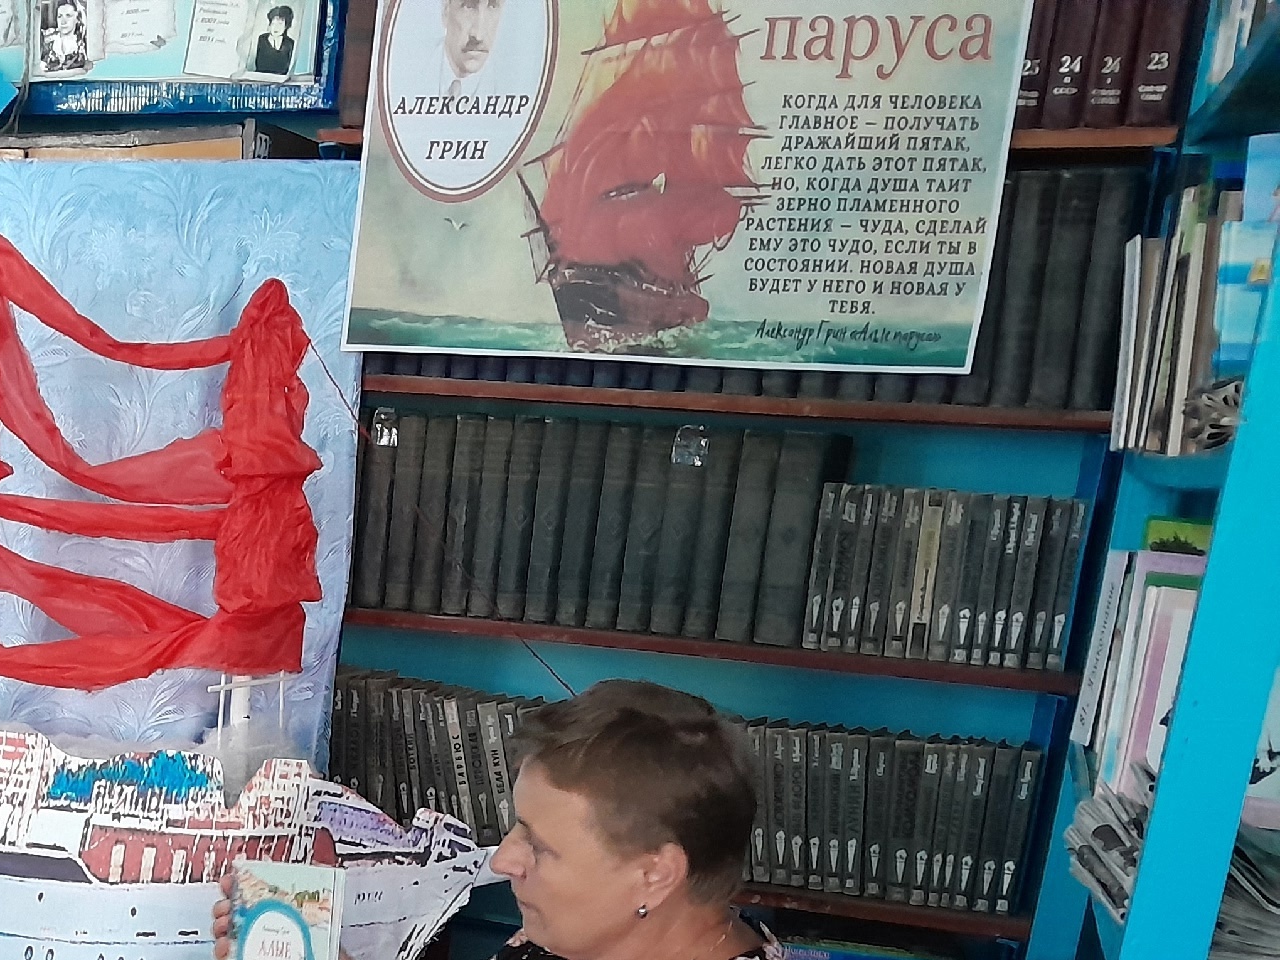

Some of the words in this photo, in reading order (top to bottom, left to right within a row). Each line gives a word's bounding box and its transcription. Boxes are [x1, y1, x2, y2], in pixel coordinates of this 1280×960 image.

[759, 14, 992, 80] паруса
[1021, 59, 1041, 76] 25
[1058, 55, 1083, 74] 24
[1101, 55, 1121, 74] 24
[1146, 52, 1169, 71] 23
[393, 95, 530, 118] АЛЕКСАНДР
[781, 94, 839, 112] КОГДА
[843, 95, 883, 112] ДЛЯ
[888, 94, 983, 110] ЧЕЛОВЕКА
[778, 115, 859, 131] ГЛАВНОЕ
[883, 116, 980, 131] ПОЛУЧАТЬ
[425, 140, 488, 160] ГРИН
[781, 132, 900, 152] ДРАЖАЙШИЙ
[906, 136, 971, 152] ПЯТАК,
[761, 156, 817, 171] ЛЕГКО
[821, 156, 866, 173] ДАТЬ
[871, 156, 918, 172] ЭТОТ
[922, 157, 987, 174] ПЯТАК,
[771, 176, 800, 192] НО,
[806, 177, 862, 193] КОГДА
[867, 177, 920, 194] ДУША
[926, 178, 972, 192] ТАИТ
[776, 197, 832, 212] ЗЕРНО
[836, 198, 960, 214] ПЛАМЕННОГО
[745, 217, 834, 232] РАСТЕНИЯ
[859, 218, 909, 236] ЧУДА,
[915, 217, 987, 236] СДЕЛАЙ
[748, 237, 783, 251] ЕМУ
[788, 237, 821, 252] ЭТО
[828, 238, 878, 256] ЧУДО,
[884, 240, 931, 255] ЕСЛИ
[936, 241, 962, 255] ТЫ
[967, 241, 977, 255] В
[743, 257, 853, 273] СОСТОЯНИИ.
[859, 259, 918, 275] НОВАЯ
[923, 261, 975, 277] ДУША
[748, 277, 802, 294] БУДЕТ
[807, 278, 818, 293] У
[822, 279, 866, 294] НЕГО
[871, 280, 883, 294] И
[889, 281, 948, 296] НОВАЯ
[955, 282, 967, 296] У
[828, 299, 876, 314] ТЕБЯ.
[755, 319, 815, 351] Александр
[816, 319, 848, 345] Грин
[407, 732, 418, 771] БОТКИН
[452, 734, 467, 786] БАРБЮС
[490, 749, 501, 767] КУН
[494, 770, 505, 794] БЕЛА
[259, 939, 292, 960] АЛЫЕ
